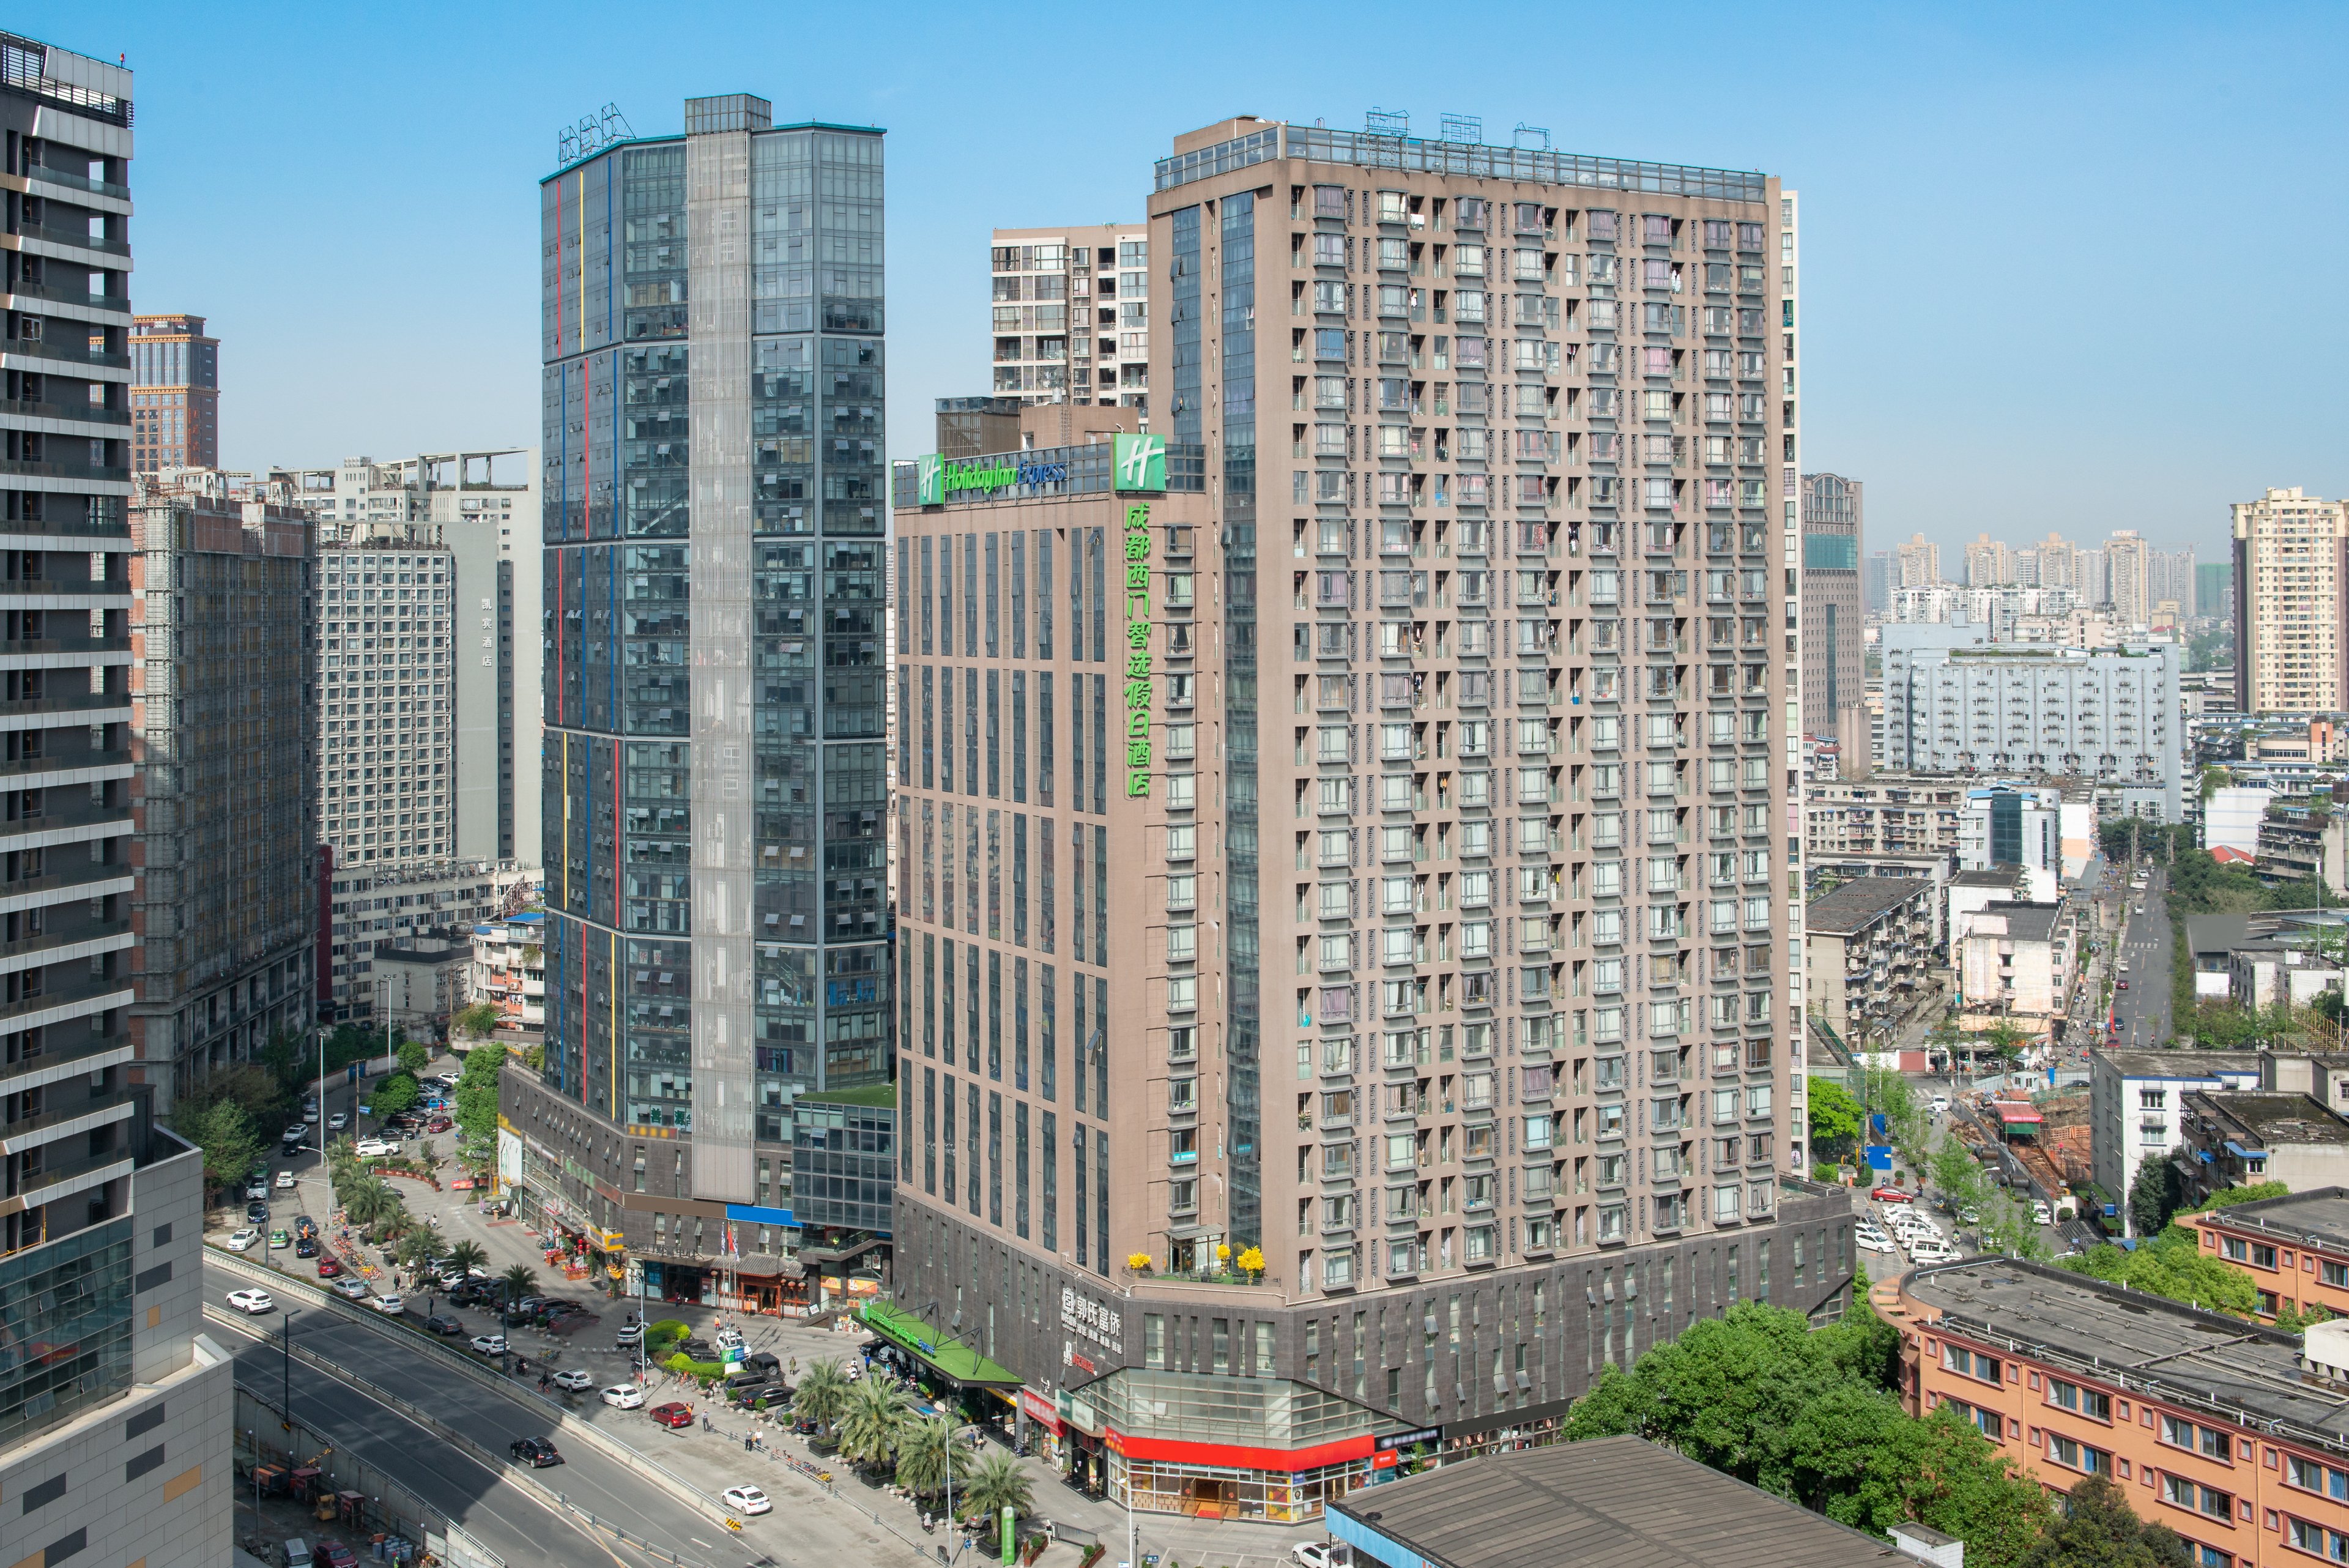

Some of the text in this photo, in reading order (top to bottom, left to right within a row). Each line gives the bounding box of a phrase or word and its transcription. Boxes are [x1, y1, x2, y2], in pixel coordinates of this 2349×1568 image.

[946, 463, 995, 494] Holiday
[1017, 461, 1067, 489] Express
[481, 598, 492, 667] 凯宾酒店
[1124, 502, 1152, 797] 成都西门智选假日酒店
[1077, 1295, 1121, 1337] 郭氏富侨
